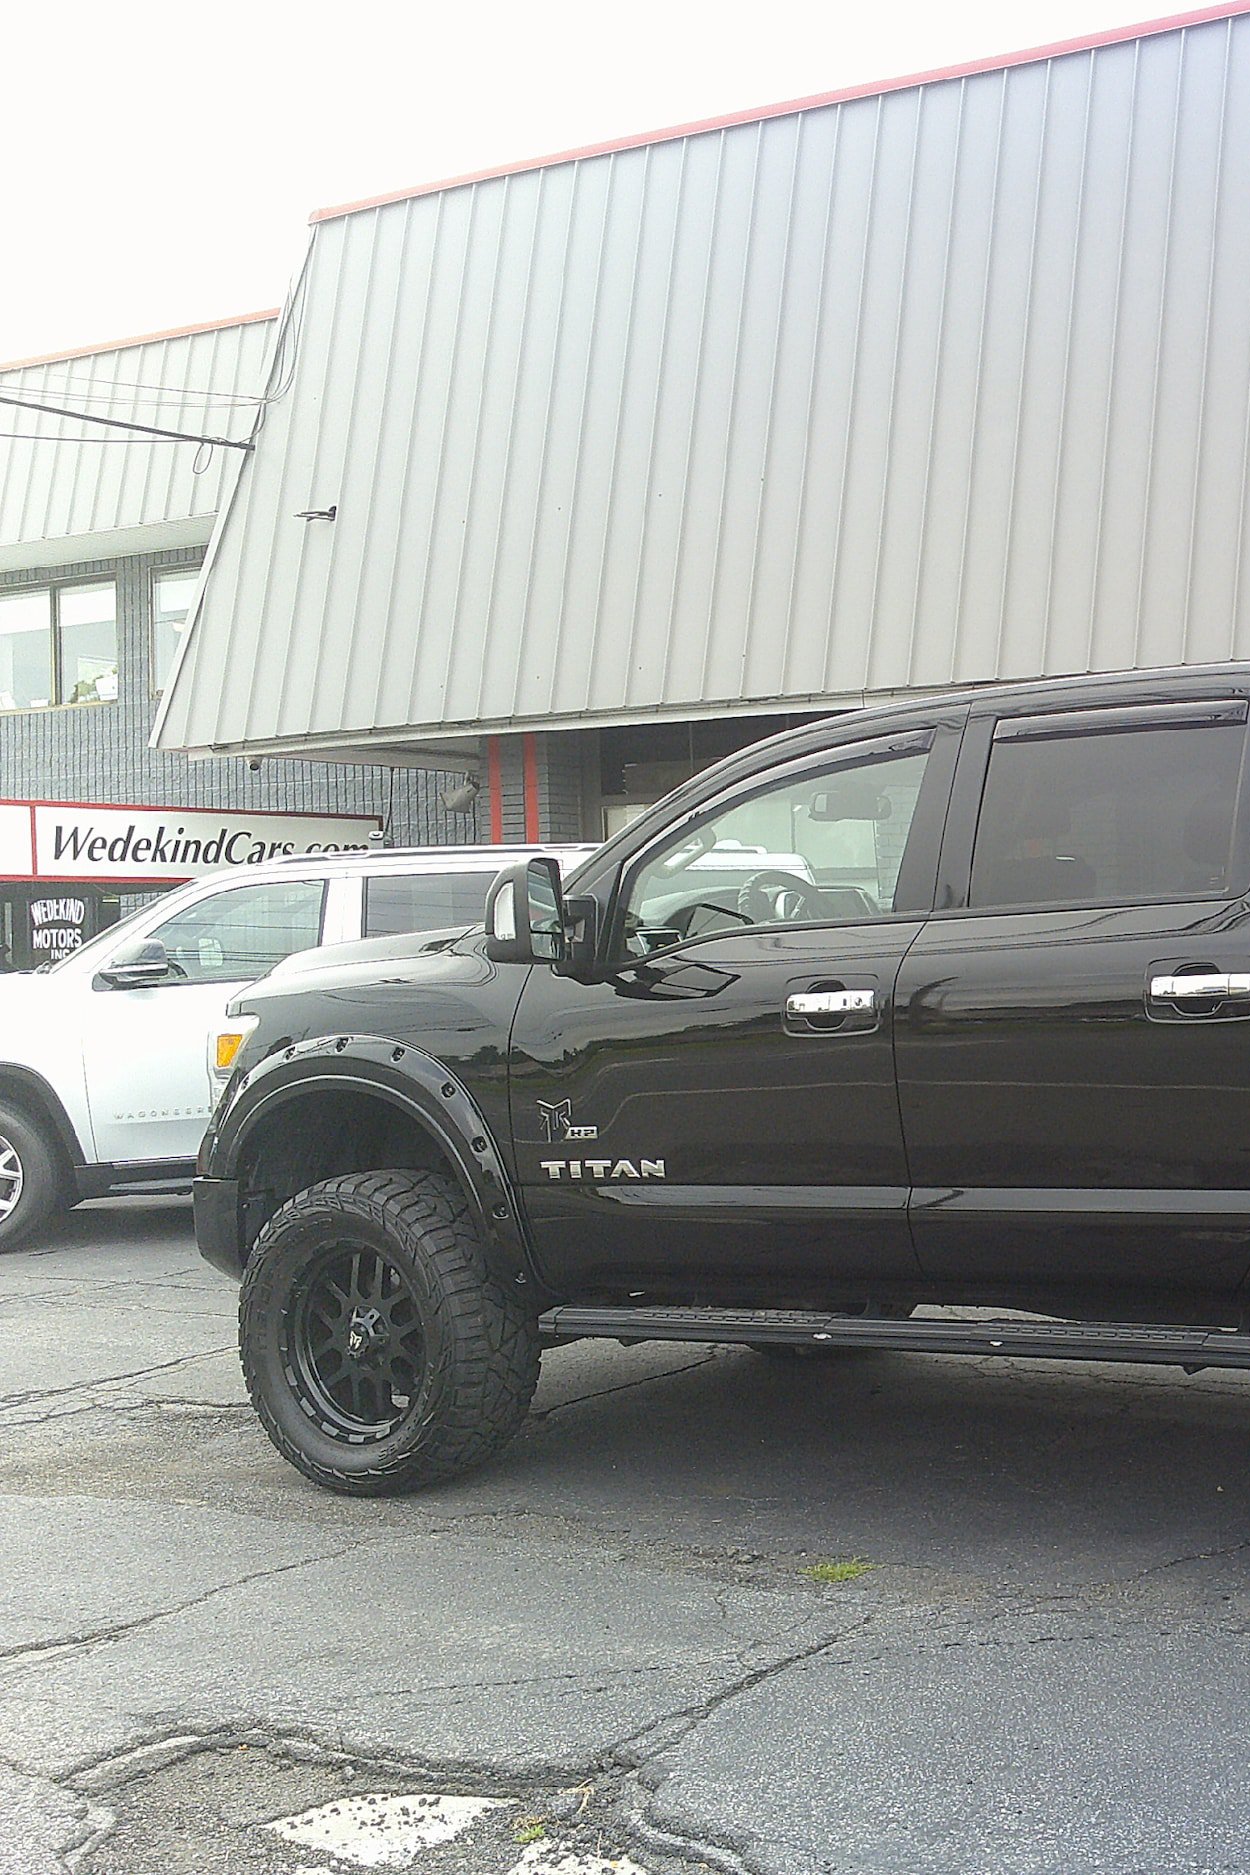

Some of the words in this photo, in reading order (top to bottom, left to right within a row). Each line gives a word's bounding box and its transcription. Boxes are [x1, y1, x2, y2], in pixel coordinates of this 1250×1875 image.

[30, 898, 85, 926] WEDEKIND
[32, 927, 83, 949] MOTORS
[540, 1160, 666, 1179] TITAN
